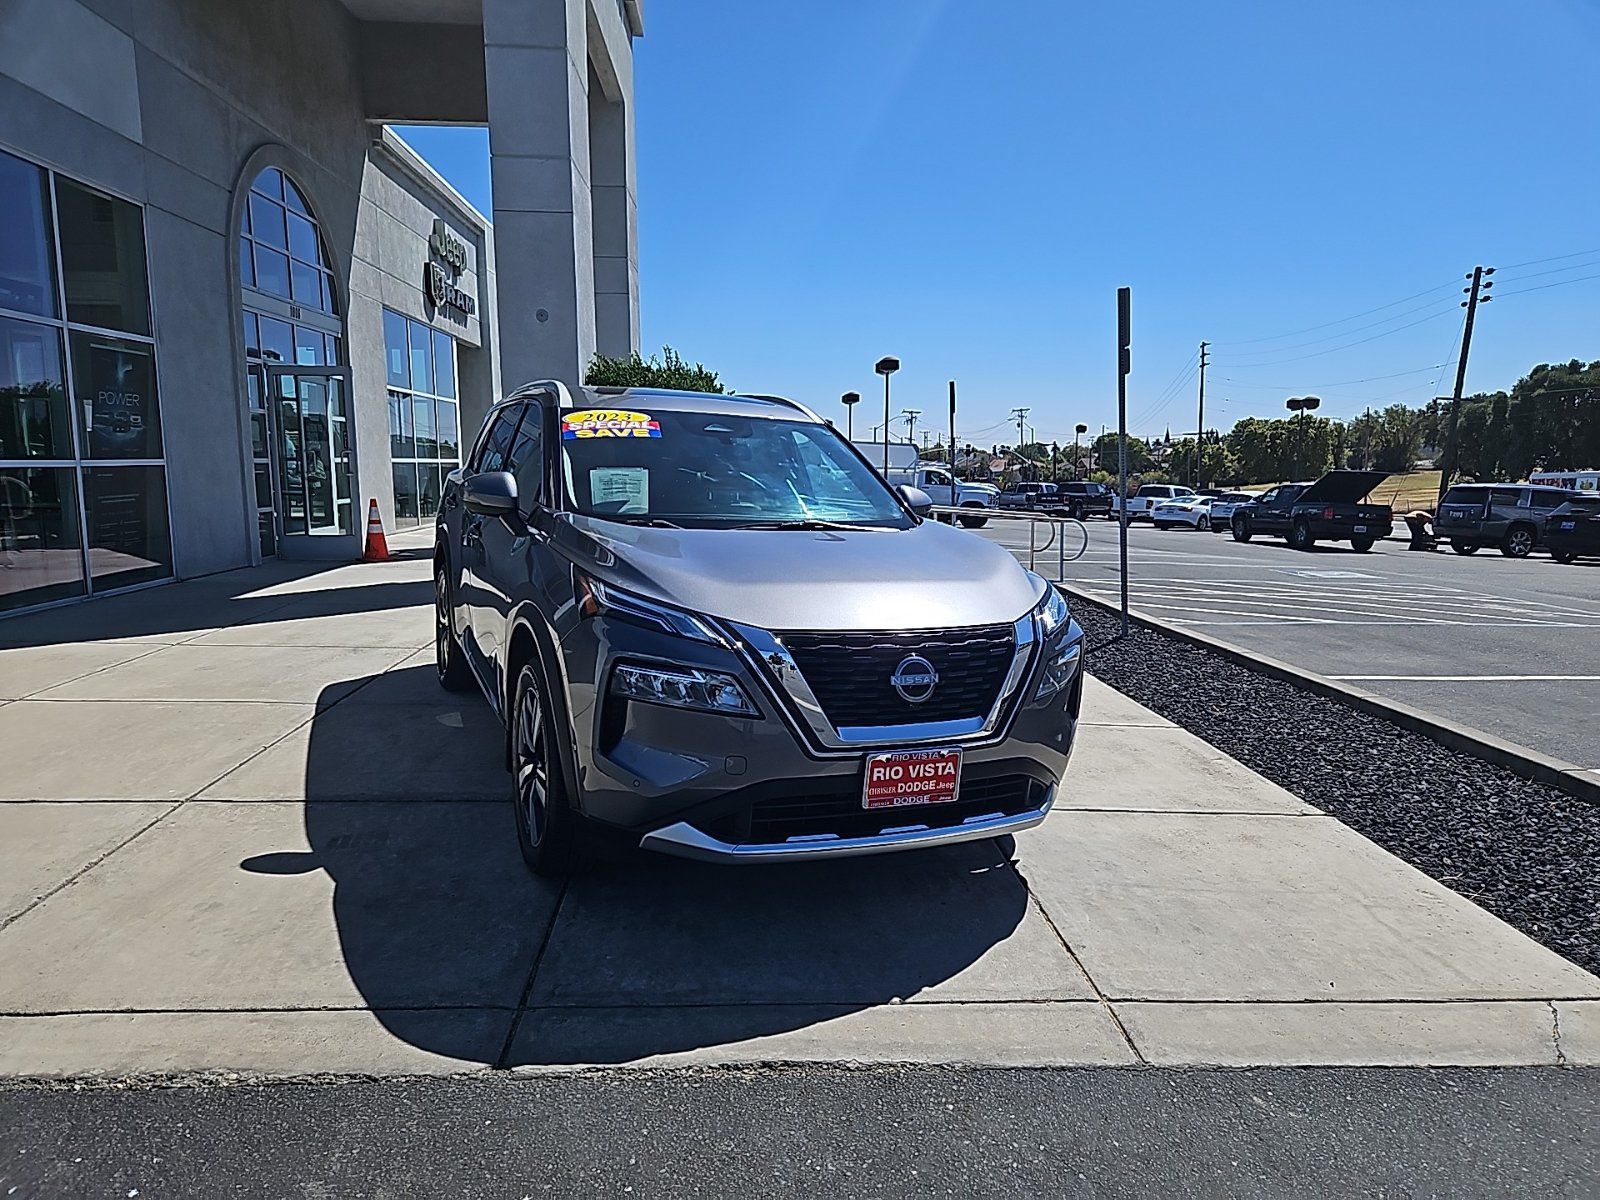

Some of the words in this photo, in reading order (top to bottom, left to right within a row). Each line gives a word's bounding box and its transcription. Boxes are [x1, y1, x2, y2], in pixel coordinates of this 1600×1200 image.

[445, 285, 475, 315] RAM
[98, 391, 140, 407] POWER
[584, 413, 632, 421] 2023
[568, 421, 656, 430] SPECIAL
[574, 428, 651, 438] SAVE
[891, 673, 938, 685] NISSAN
[892, 754, 910, 762] RIO
[912, 752, 939, 760] VISTA
[872, 766, 903, 782] RIO
[909, 762, 955, 778] VISTA
[897, 780, 936, 793] DODGE
[936, 781, 954, 790] Jeep
[893, 795, 930, 805] DODGE
